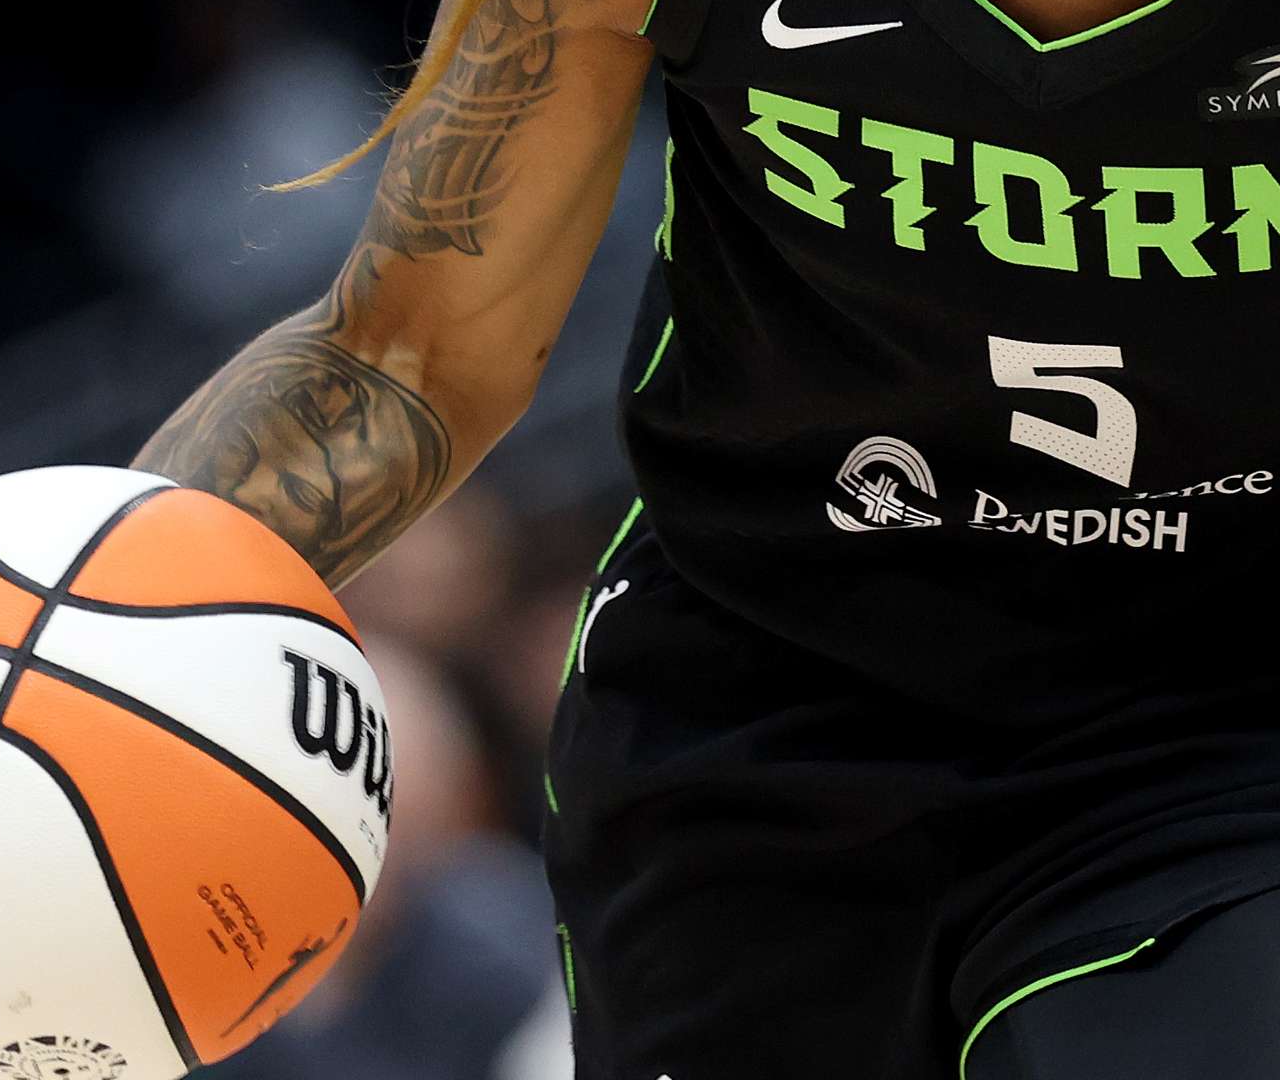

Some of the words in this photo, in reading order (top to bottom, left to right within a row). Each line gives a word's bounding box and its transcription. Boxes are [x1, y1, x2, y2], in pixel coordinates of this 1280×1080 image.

[988, 335, 1138, 488] 5
[968, 508, 1188, 552] WEDISH
[282, 647, 391, 820] Wil
[197, 884, 239, 935] GAME
[232, 931, 258, 972] BALL
